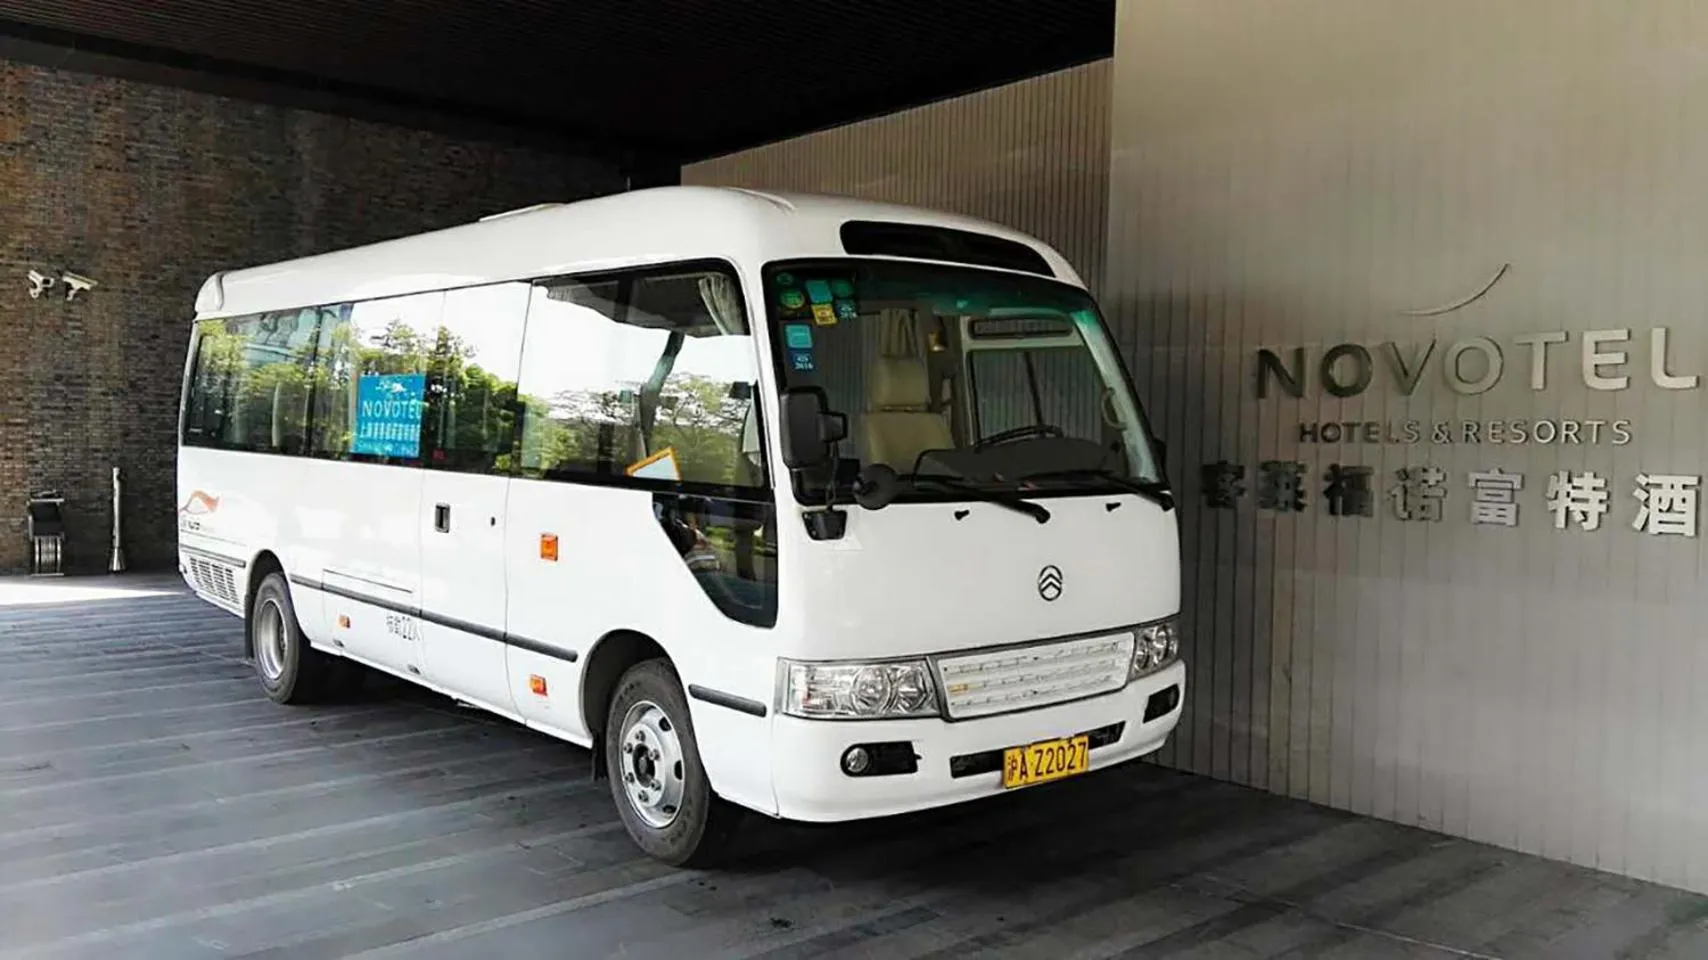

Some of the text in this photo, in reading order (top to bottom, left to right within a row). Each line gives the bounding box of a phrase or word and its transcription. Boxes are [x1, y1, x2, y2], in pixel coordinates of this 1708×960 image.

[1256, 327, 1699, 399] NOVOTEL
[362, 400, 421, 419] NOVOTEL
[1299, 419, 1634, 445] HOTELS & RESORTS
